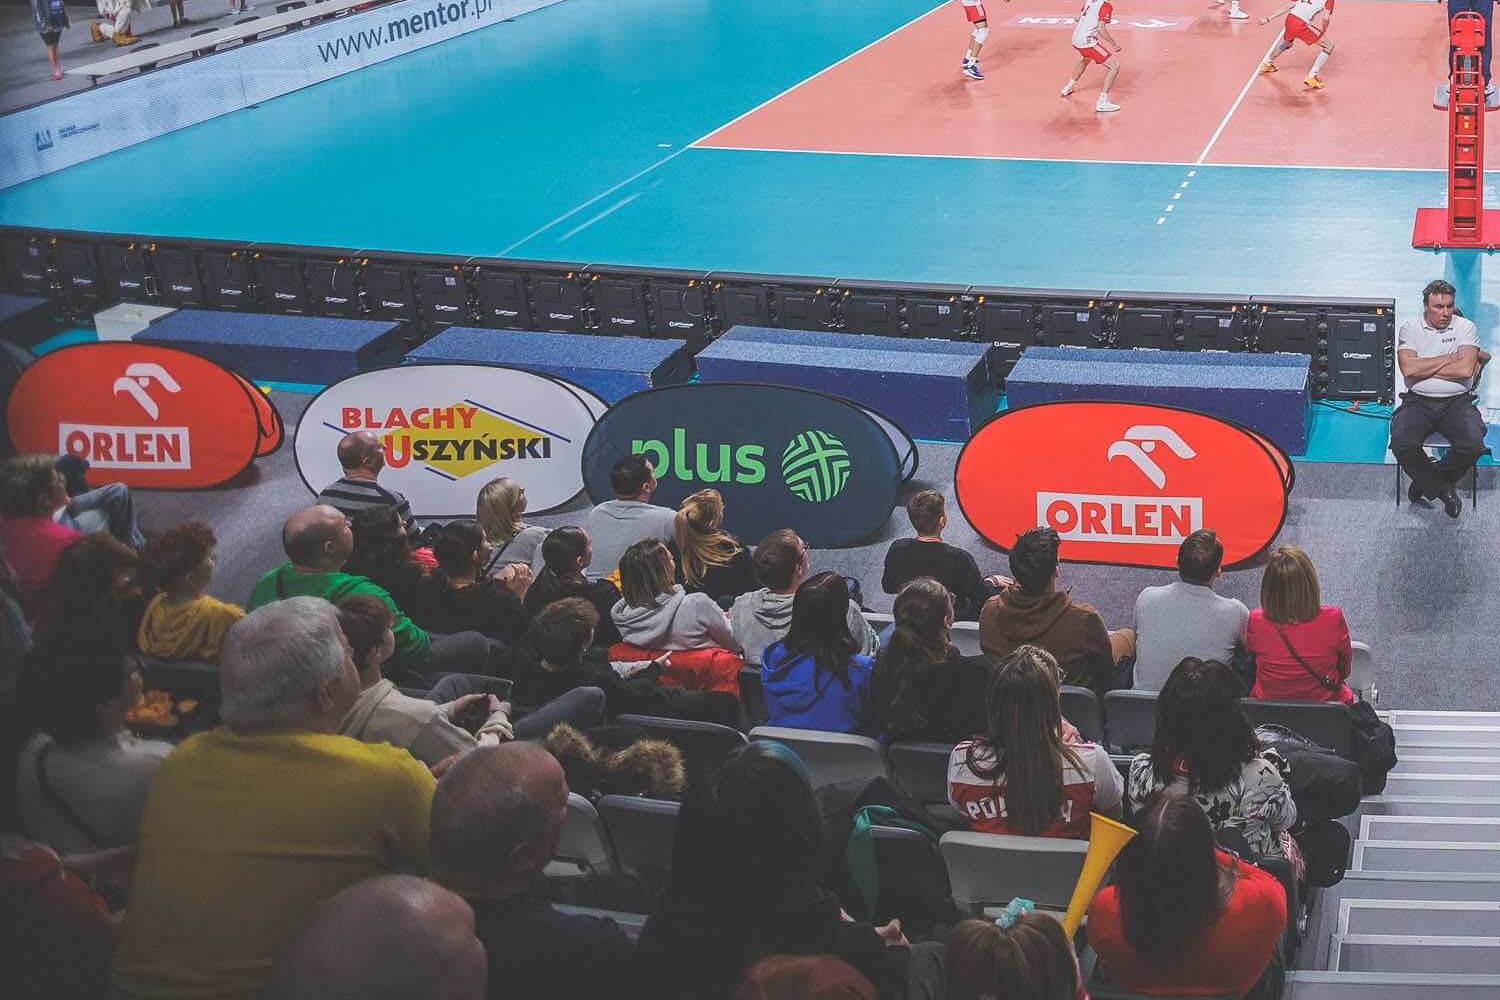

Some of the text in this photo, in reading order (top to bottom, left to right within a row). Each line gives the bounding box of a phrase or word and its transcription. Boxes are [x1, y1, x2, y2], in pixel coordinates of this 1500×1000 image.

[342, 407, 478, 429] BLACHY
[65, 431, 182, 463] ORLEN
[384, 433, 551, 468] USZYŃSKI
[1046, 500, 1192, 536] ORLEN
